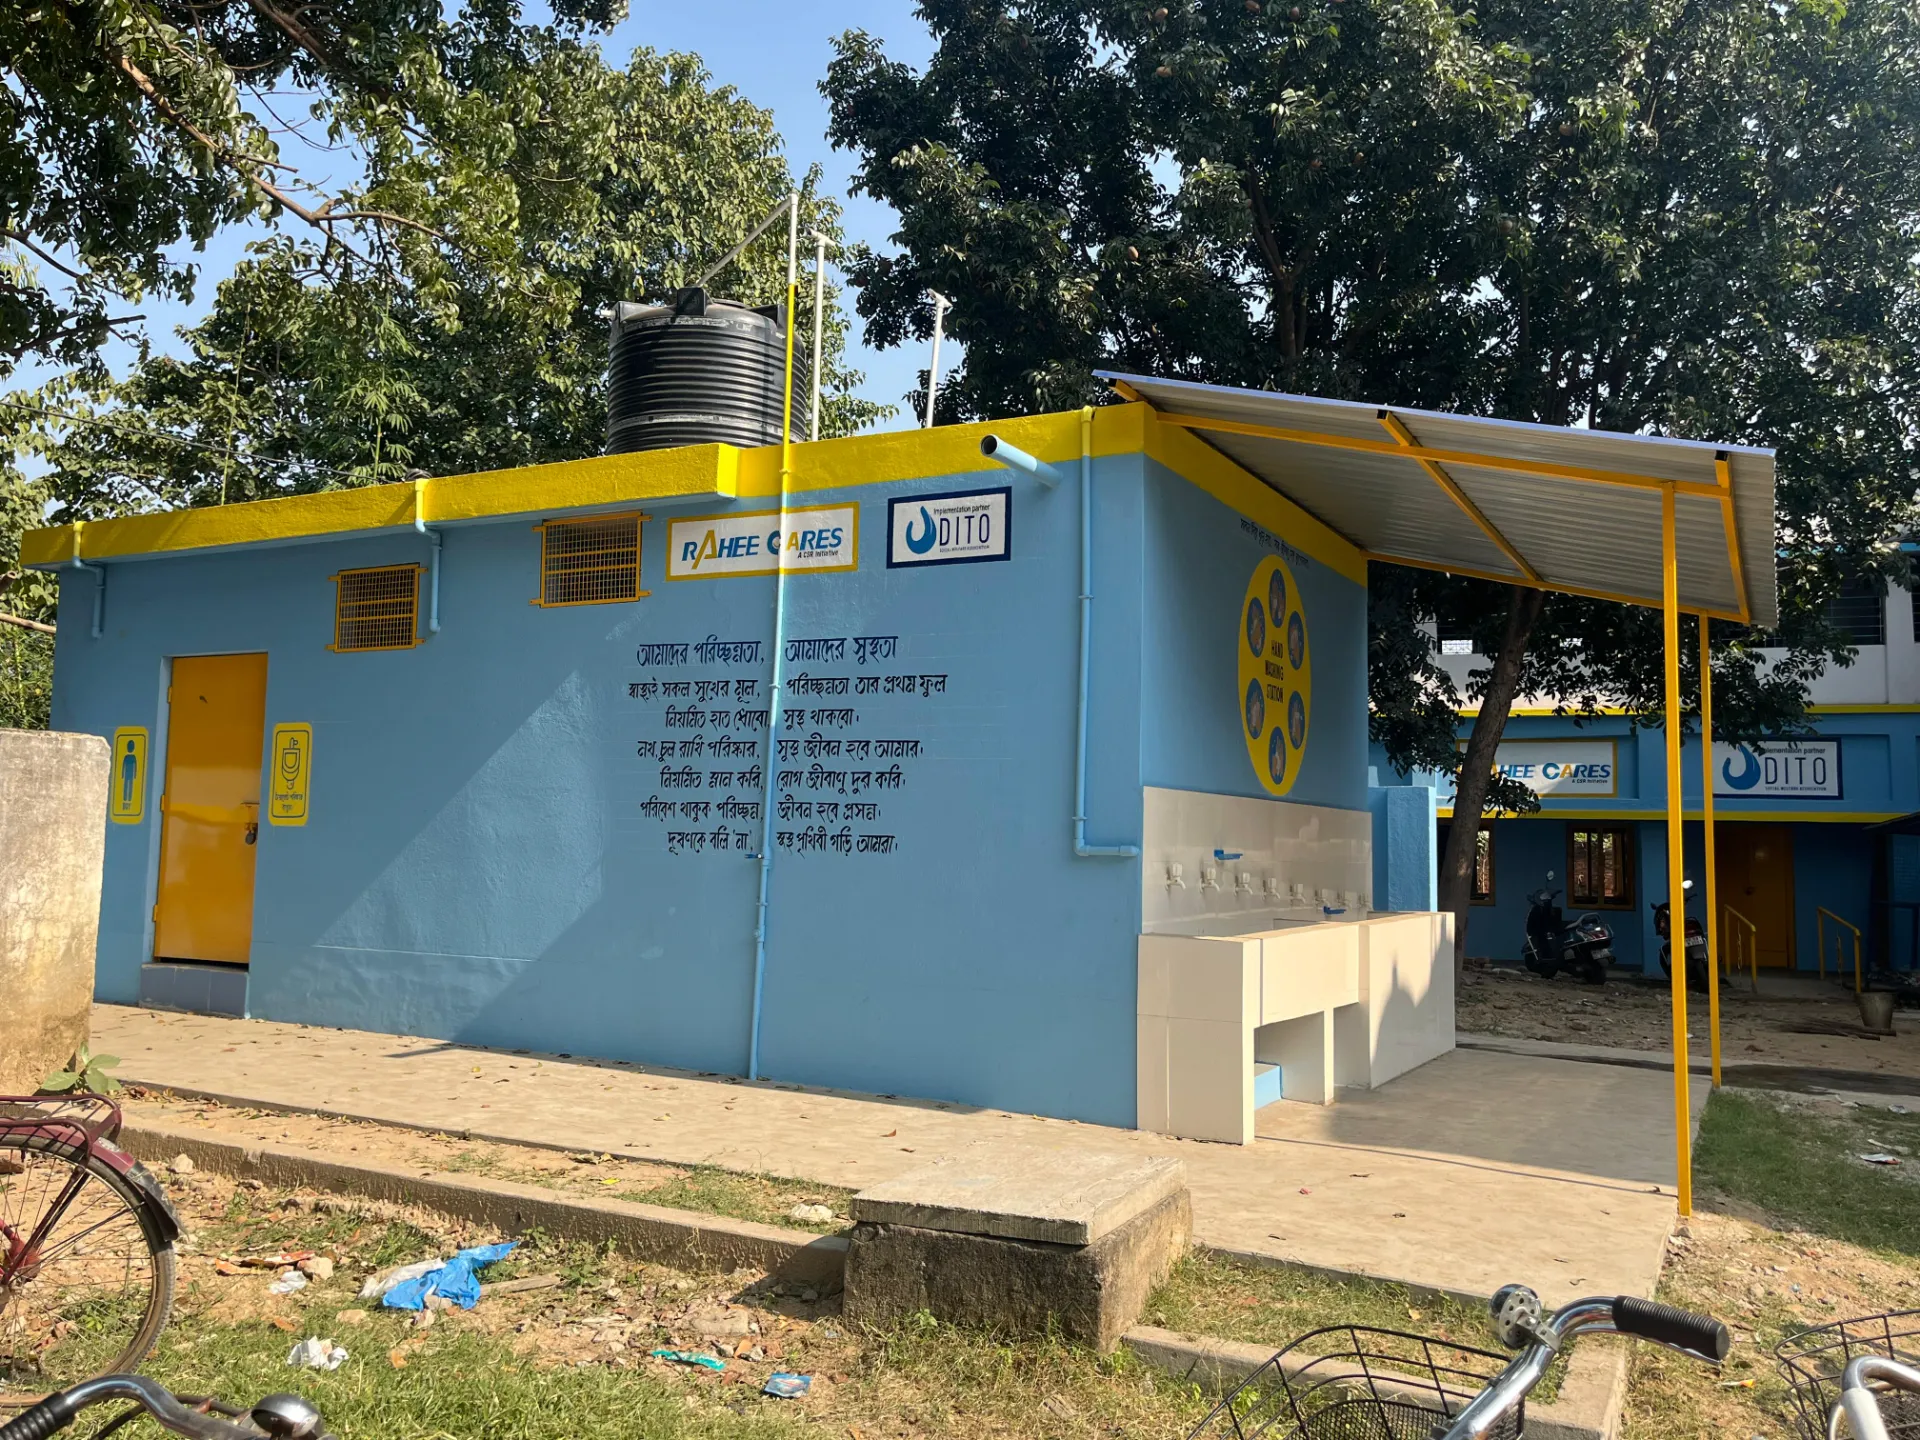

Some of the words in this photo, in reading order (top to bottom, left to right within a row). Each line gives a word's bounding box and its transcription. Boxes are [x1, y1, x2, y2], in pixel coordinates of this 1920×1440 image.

[682, 529, 760, 570] RAHEE
[767, 527, 844, 556] CARES
[637, 643, 689, 667] আমাদের
[694, 634, 764, 667] পরিচ্ছন্নতা,
[785, 637, 847, 663] আমাদের
[853, 635, 898, 665] সুস্থতা
[662, 681, 691, 698] সকল
[694, 680, 731, 702] সুখের
[786, 672, 850, 699] পরিচ্ছন্নতা
[855, 676, 880, 695] তার
[884, 674, 916, 694] প্রথম
[919, 674, 948, 698] ফুল
[665, 704, 706, 728] নিয়মিত
[709, 710, 731, 732] হাত
[783, 708, 805, 732] সুস্থ
[679, 734, 705, 758] রাখি
[777, 739, 800, 762] সুস্থ
[804, 732, 842, 759] জীবন
[845, 740, 871, 761] হবে
[660, 765, 702, 789] নিয়মিত
[708, 771, 734, 789] স্নান
[737, 764, 763, 794] করি,
[777, 770, 803, 791] রোগ
[806, 763, 848, 796] জীবাণু
[1542, 763, 1611, 780] CARES
[640, 795, 677, 822] পরিবেশ
[680, 801, 711, 823] থাকুক
[778, 794, 813, 821] জীবন
[816, 802, 840, 823] হবে
[710, 825, 729, 849] বলি
[796, 825, 828, 859] পৃথিবী
[830, 826, 852, 856] গড়ি
